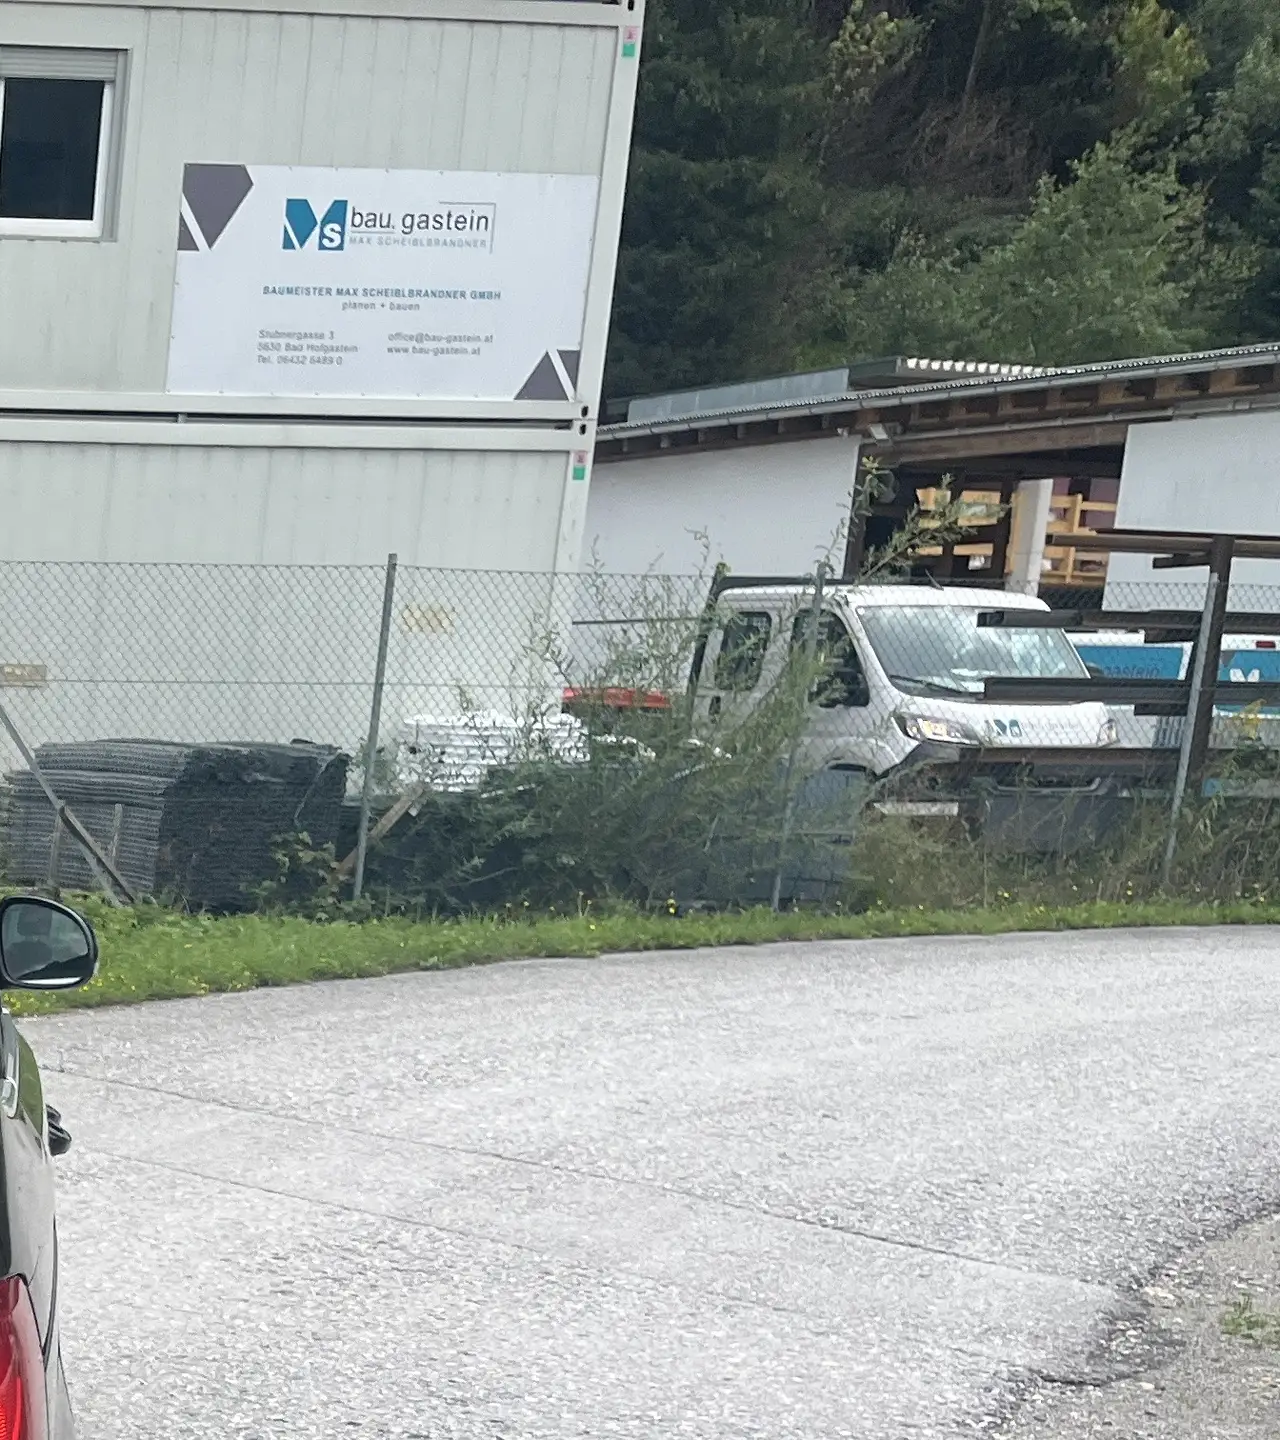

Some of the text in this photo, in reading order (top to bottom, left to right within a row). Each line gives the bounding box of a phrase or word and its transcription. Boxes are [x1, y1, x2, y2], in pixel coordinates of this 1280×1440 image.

[401, 209, 490, 235] gastein
[349, 236, 372, 246] MAX
[262, 285, 502, 301] BAUMEISTER MAX SCHEIBLBRANDNER GMBH
[341, 301, 376, 312] planen
[389, 302, 420, 312] bauen
[284, 342, 304, 352] Bad
[306, 343, 359, 354] Hofgastein
